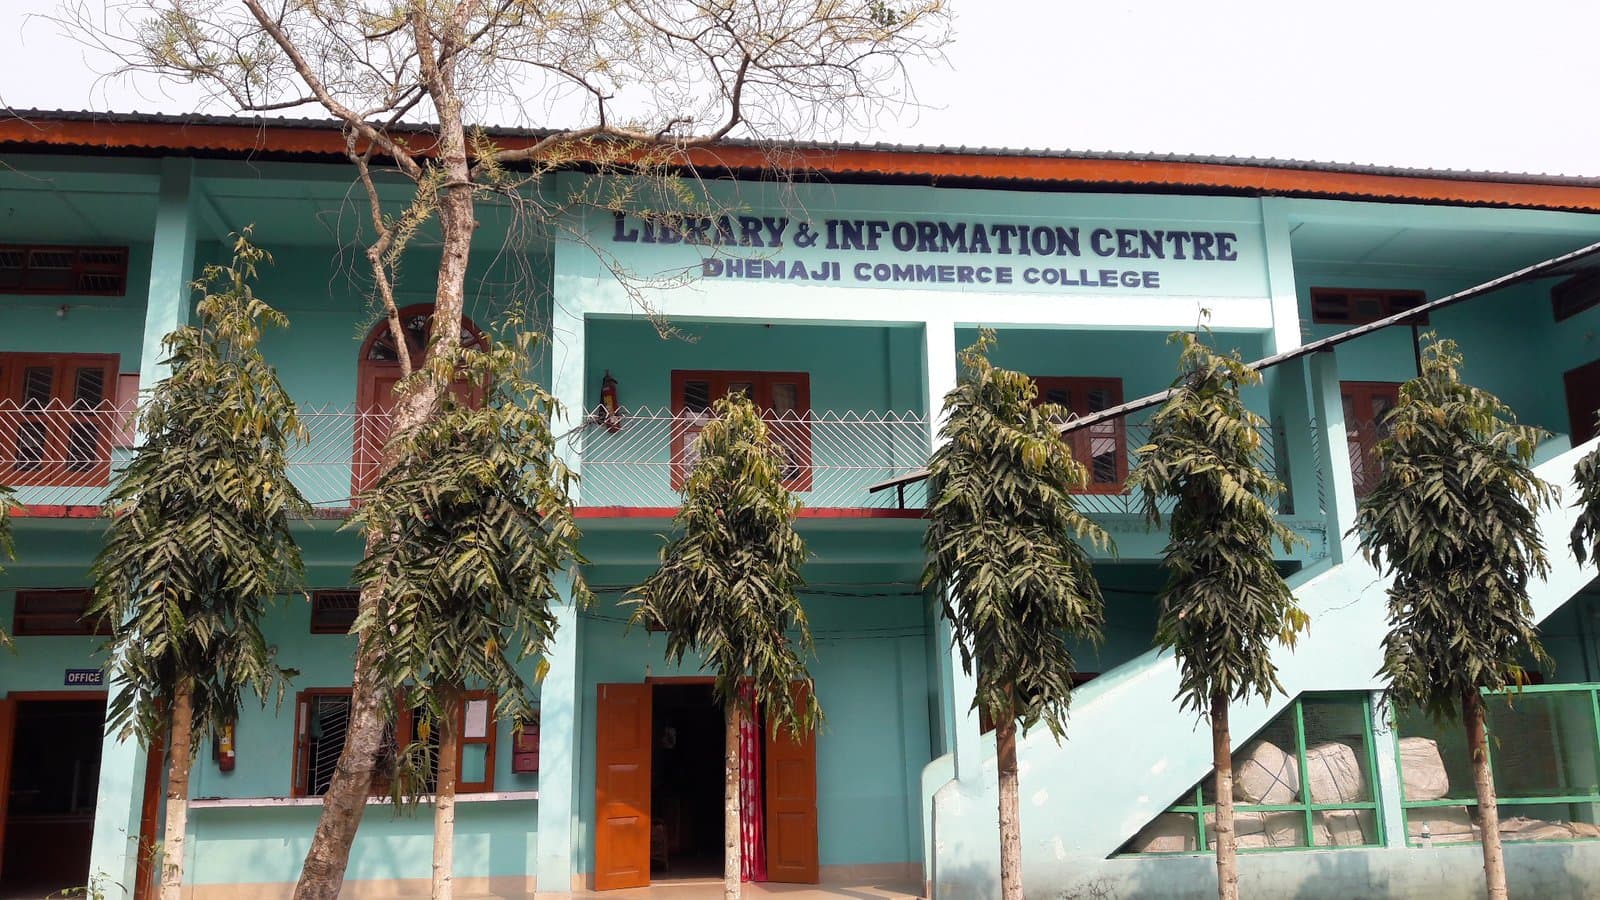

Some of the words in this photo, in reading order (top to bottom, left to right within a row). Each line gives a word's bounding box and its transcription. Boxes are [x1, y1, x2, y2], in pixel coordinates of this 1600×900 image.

[613, 211, 789, 247] LIBRARY
[793, 223, 820, 248] &
[825, 219, 1081, 257] INFORMATION
[1091, 228, 1238, 261] CENTRE
[702, 257, 841, 281] DHEMAJI
[854, 262, 1013, 284] COMMERCE
[1023, 267, 1161, 289] COLLEGE
[69, 673, 100, 682] OFFICE
